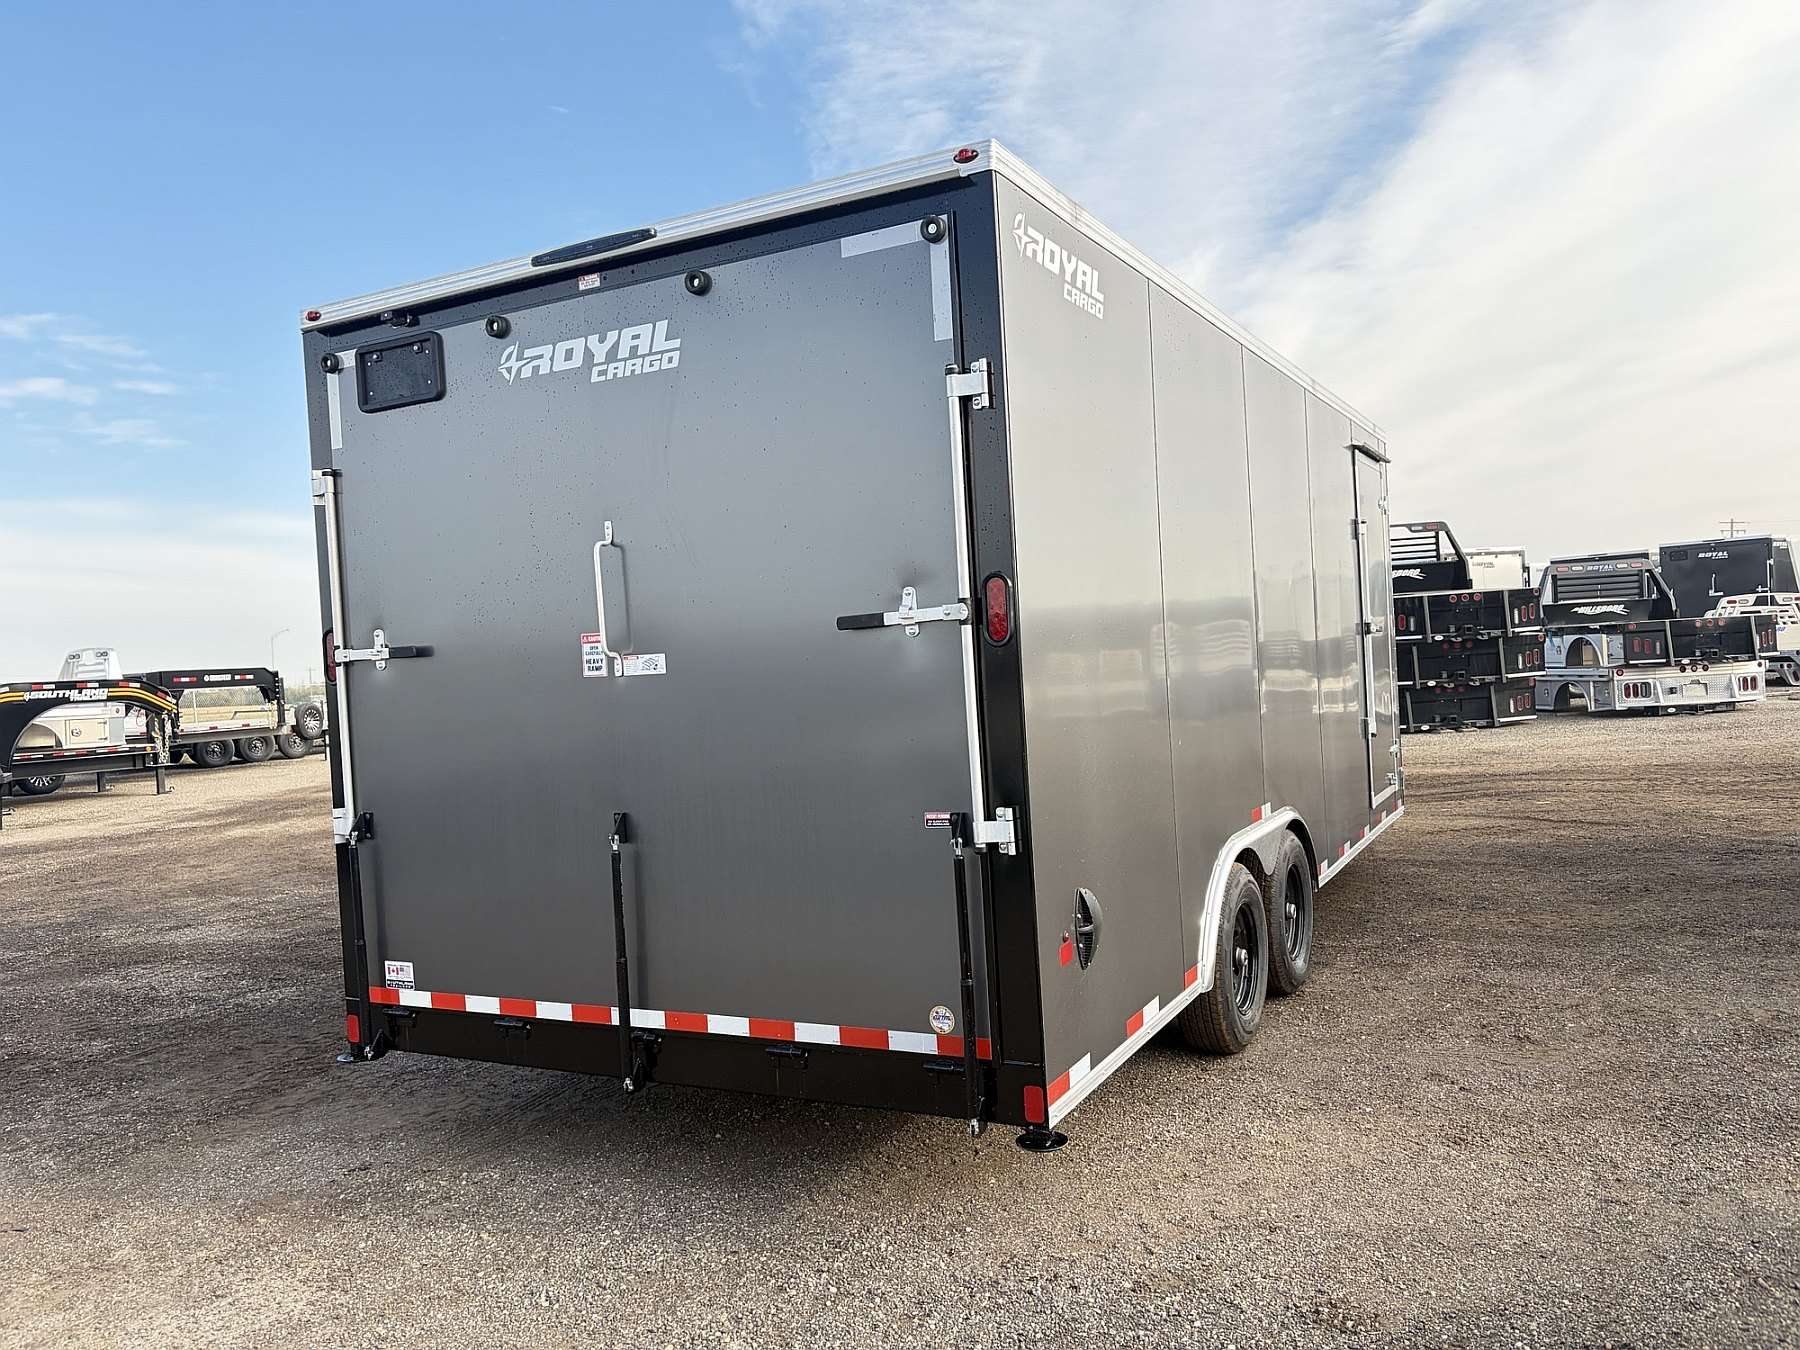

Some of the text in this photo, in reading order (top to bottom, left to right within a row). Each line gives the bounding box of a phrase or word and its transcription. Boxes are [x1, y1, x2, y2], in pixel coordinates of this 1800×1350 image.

[1026, 224, 1104, 303] ROYAL
[1064, 282, 1104, 320] CARGO
[520, 319, 681, 379] ROYAL
[591, 350, 681, 383] CARGO
